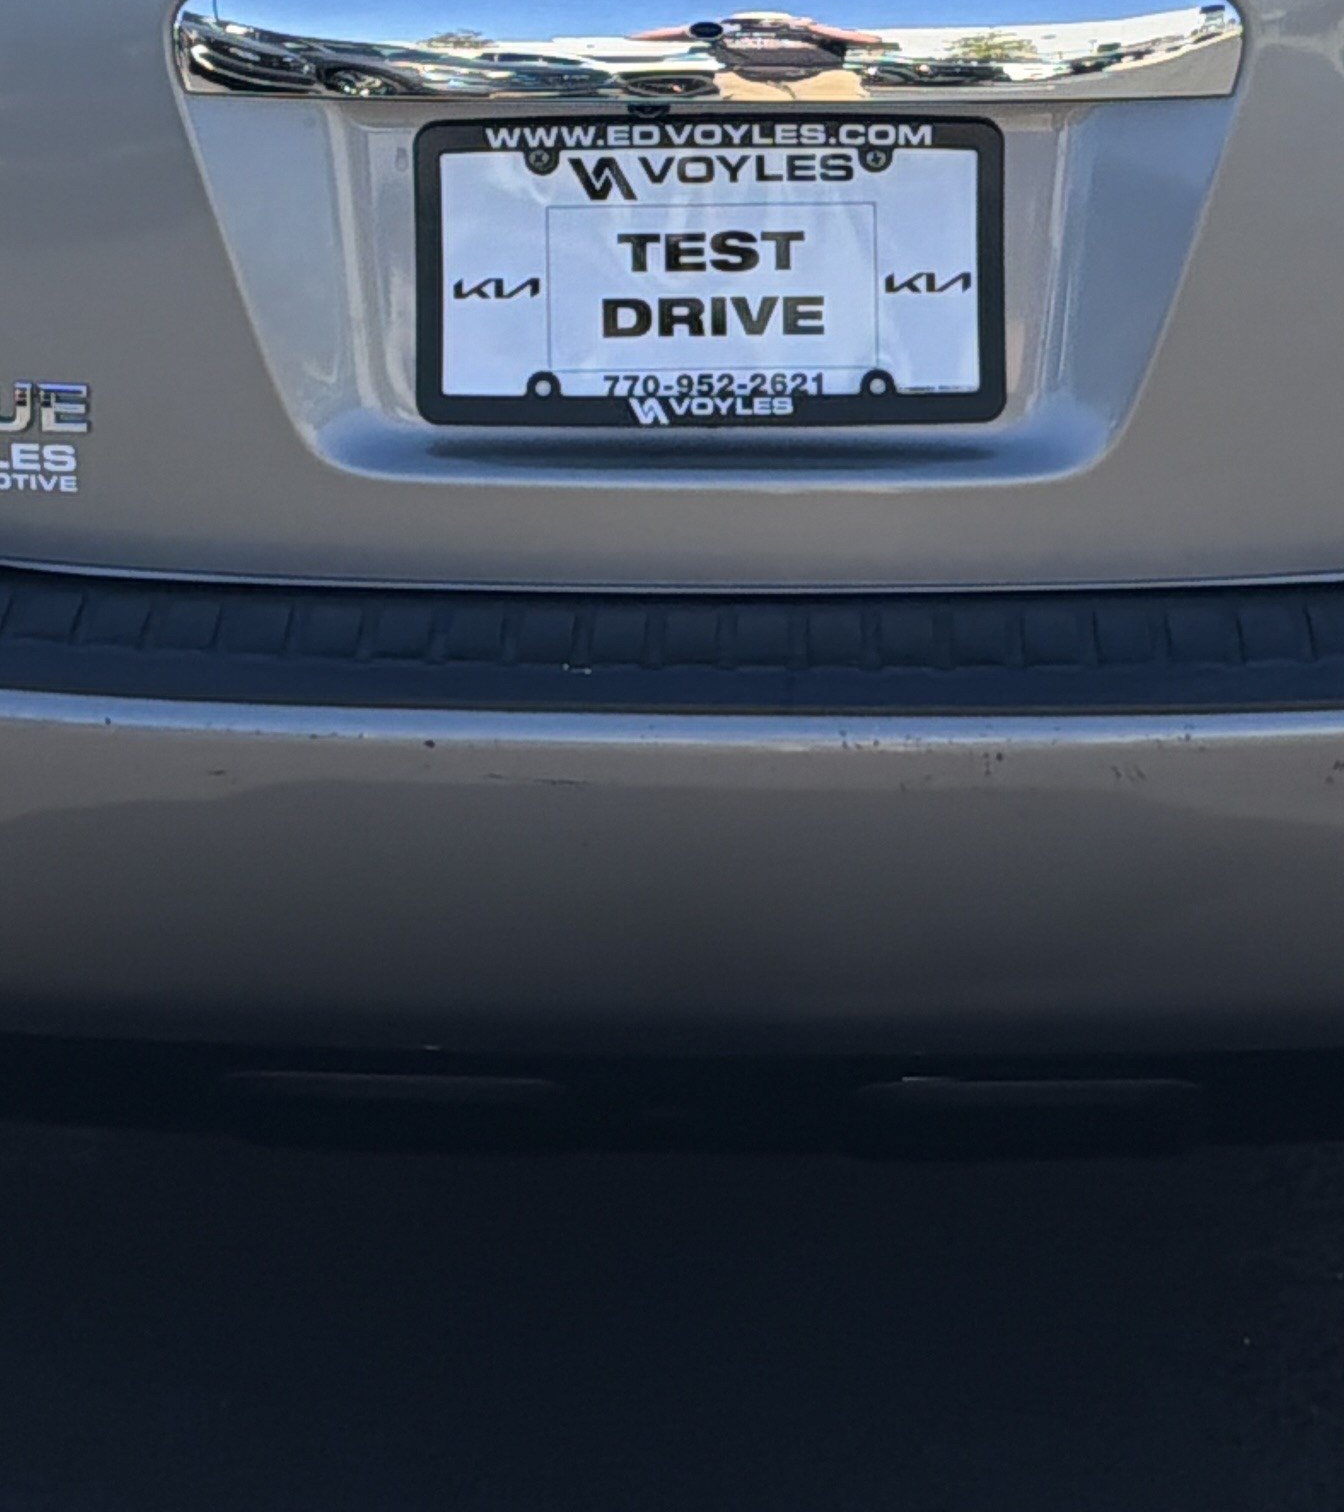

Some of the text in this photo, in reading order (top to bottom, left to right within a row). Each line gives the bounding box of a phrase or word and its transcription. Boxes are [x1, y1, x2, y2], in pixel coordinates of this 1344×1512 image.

[485, 123, 933, 148] WWW.EDVOYLES.COM
[638, 154, 855, 184] VOYLES
[617, 230, 805, 273] TEST
[602, 295, 825, 338] DRIVE
[603, 372, 824, 396] 770-952-2621
[669, 397, 794, 416] VOYLES
